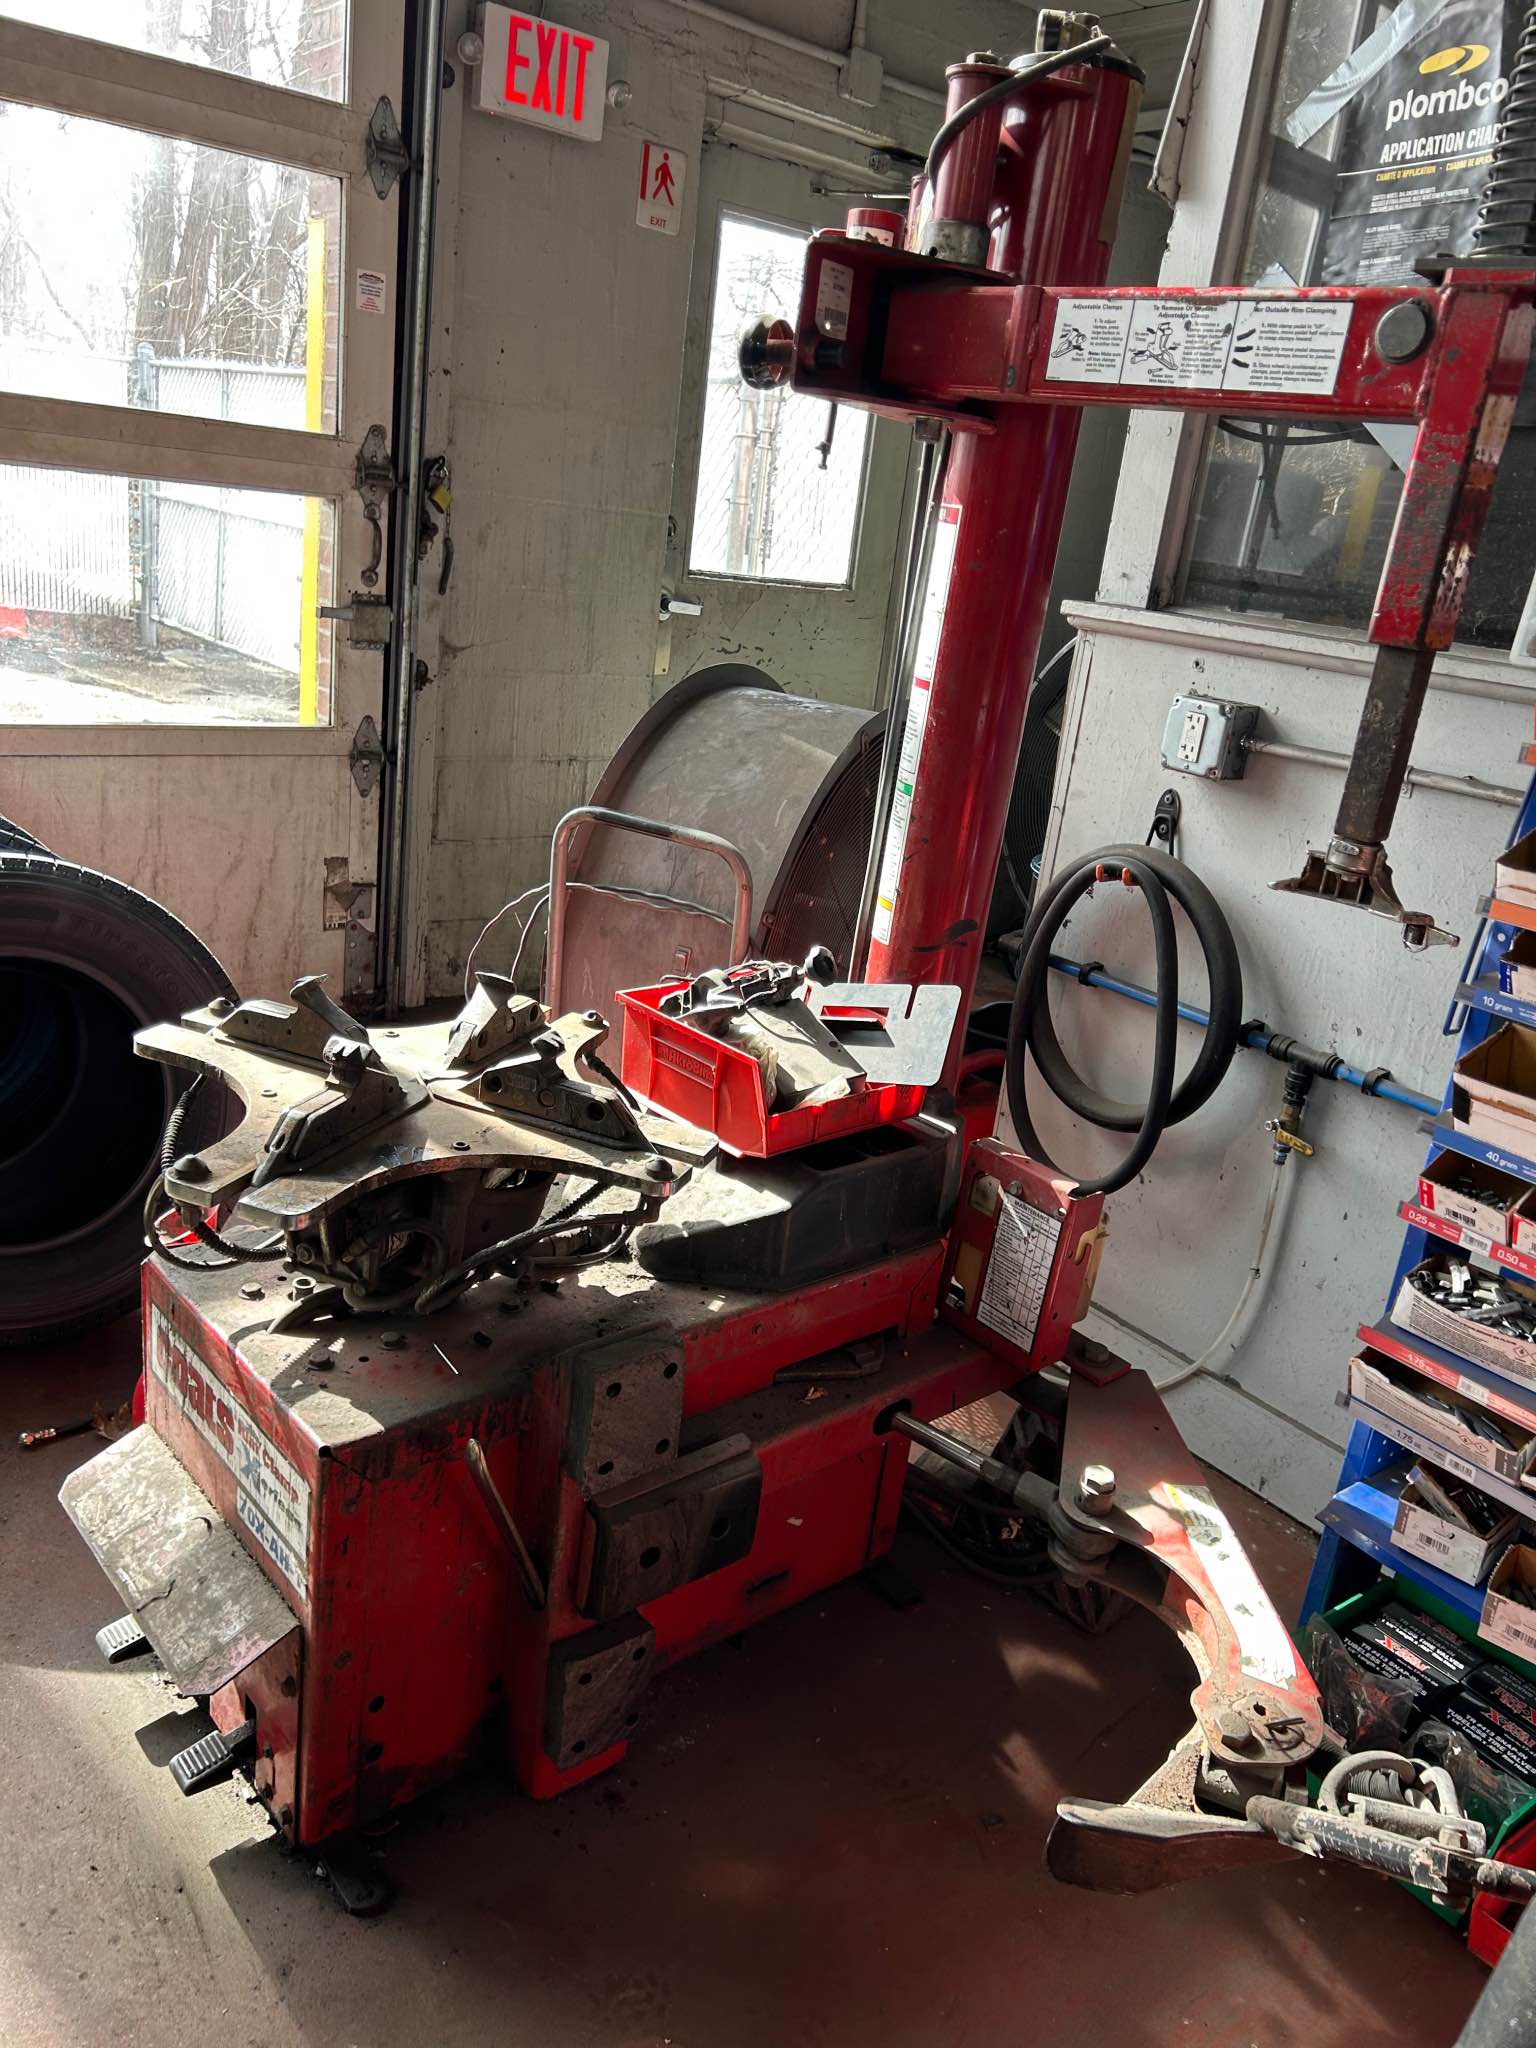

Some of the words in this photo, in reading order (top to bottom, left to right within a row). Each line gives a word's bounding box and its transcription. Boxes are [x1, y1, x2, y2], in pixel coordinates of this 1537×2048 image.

[504, 15, 594, 121] EXIT
[1385, 79, 1508, 130] plombco
[1380, 130, 1465, 164] APPLICATION
[650, 216, 667, 228] EXIT
[1482, 996, 1494, 1006] 10
[1486, 1151, 1500, 1162] 40
[1014, 1199, 1050, 1224] MAINTENANCE
[1408, 1210, 1428, 1225] 0.25
[1498, 1249, 1519, 1264] 0.50
[1396, 1428, 1414, 1444] 1.75
[262, 1447, 299, 1504] Clamp
[1342, 1637, 1381, 1664] TUBELESS
[1380, 1663, 1399, 1677] TIRE
[1360, 1642, 1372, 1651] TR
[1387, 1661, 1419, 1682] SNAP-IN
[1435, 1649, 1465, 1669] VALVES
[1445, 1708, 1488, 1738] TUBELESS
[1486, 1737, 1506, 1751] TIRE
[1505, 1750, 1536, 1773] VALVES
[1461, 1726, 1482, 1741] Length
[1501, 1754, 1515, 1764] Rim
[1465, 1715, 1476, 1723] TR
[1475, 1722, 1495, 1736] #413
[1493, 1735, 1528, 1759] SNAP-IN
